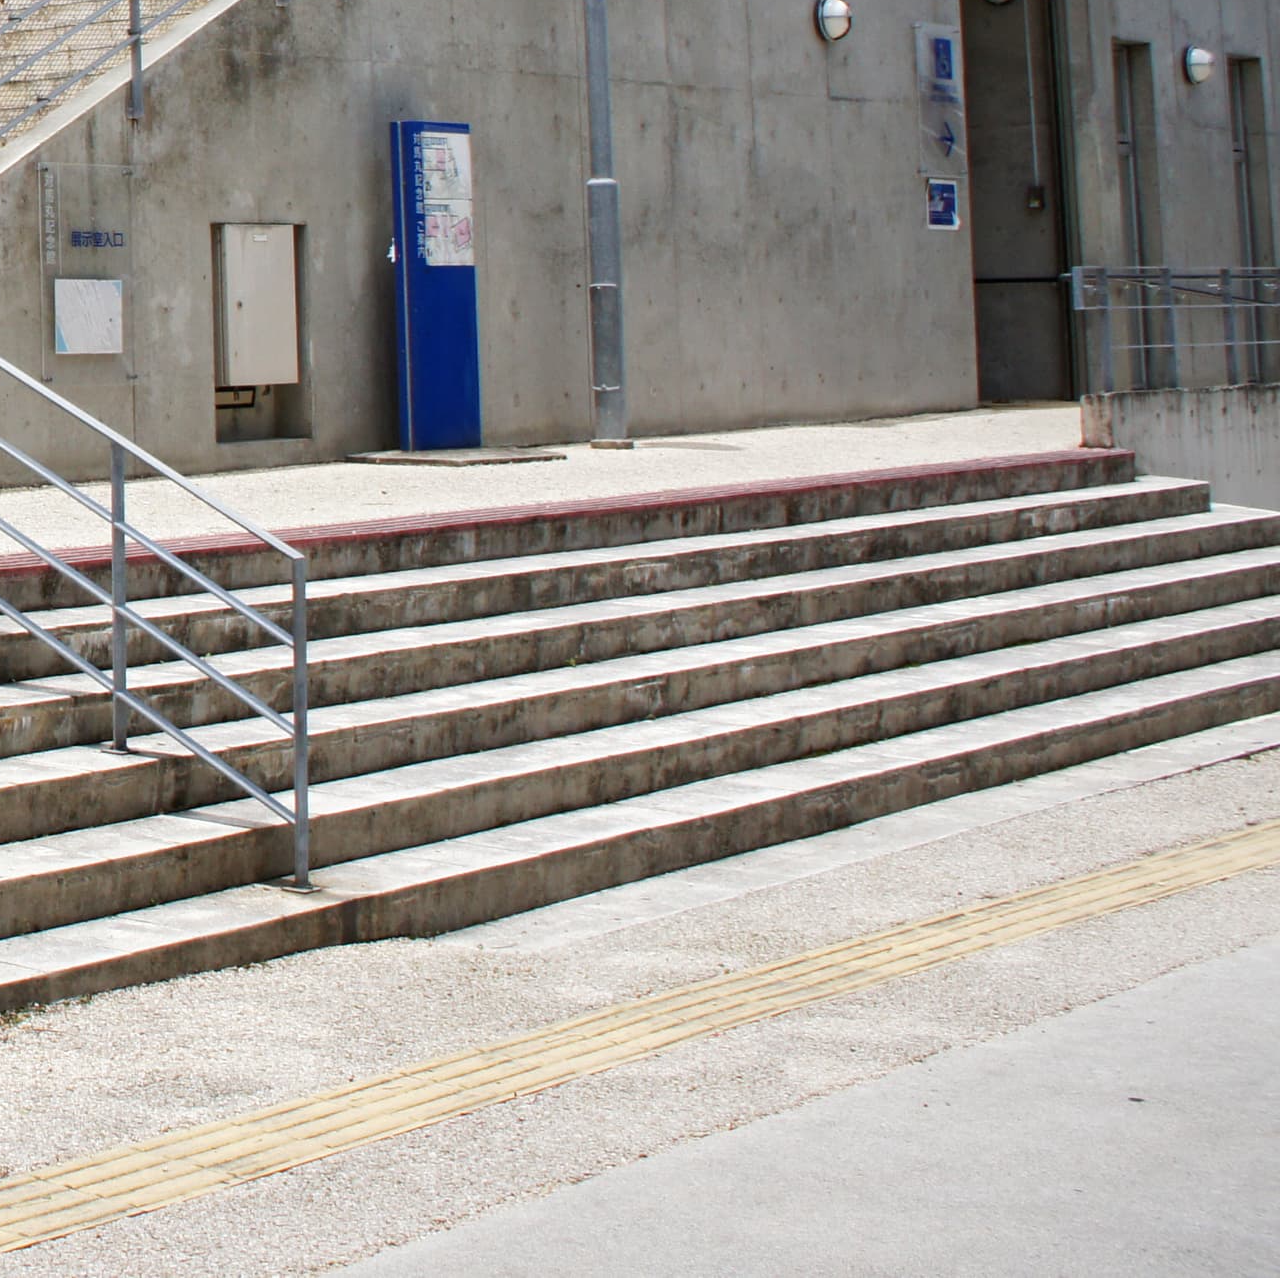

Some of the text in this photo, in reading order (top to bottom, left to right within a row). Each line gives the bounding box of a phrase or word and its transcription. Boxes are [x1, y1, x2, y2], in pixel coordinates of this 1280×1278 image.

[71, 231, 123, 248] 展示室入口
